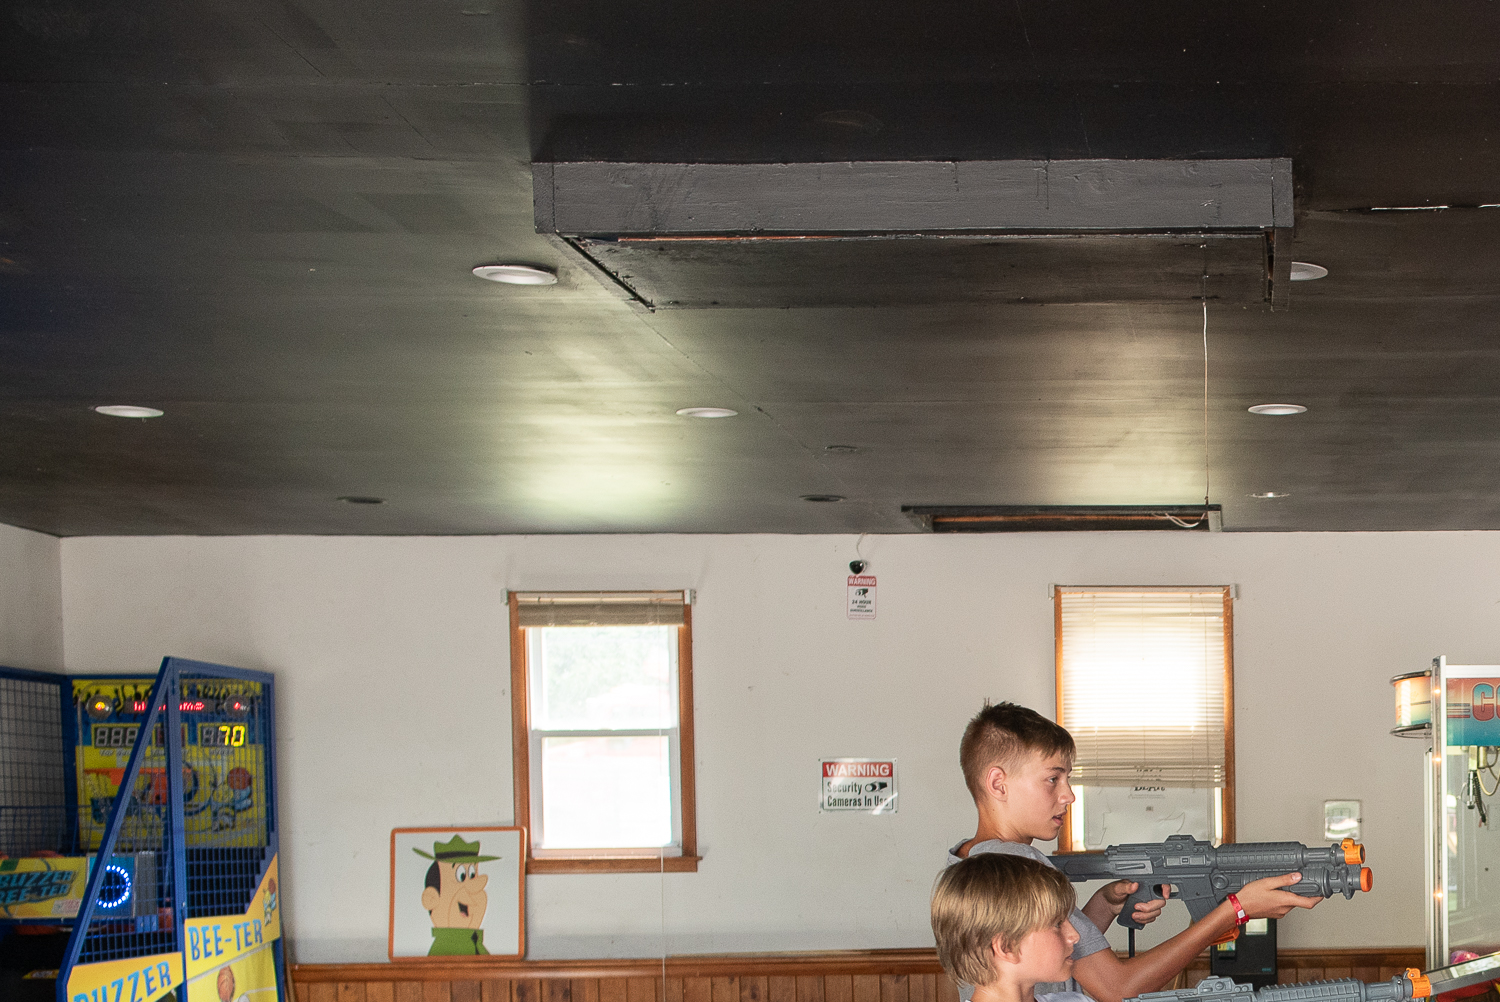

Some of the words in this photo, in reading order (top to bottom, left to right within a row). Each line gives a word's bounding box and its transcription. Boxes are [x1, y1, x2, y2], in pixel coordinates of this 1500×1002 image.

[849, 577, 875, 586] WARNING
[219, 725, 246, 747] 70
[826, 764, 889, 776] WARNING
[827, 781, 862, 795] Security
[827, 795, 861, 807] Cameras
[864, 796, 872, 806] In
[188, 918, 263, 961] BEE-TER
